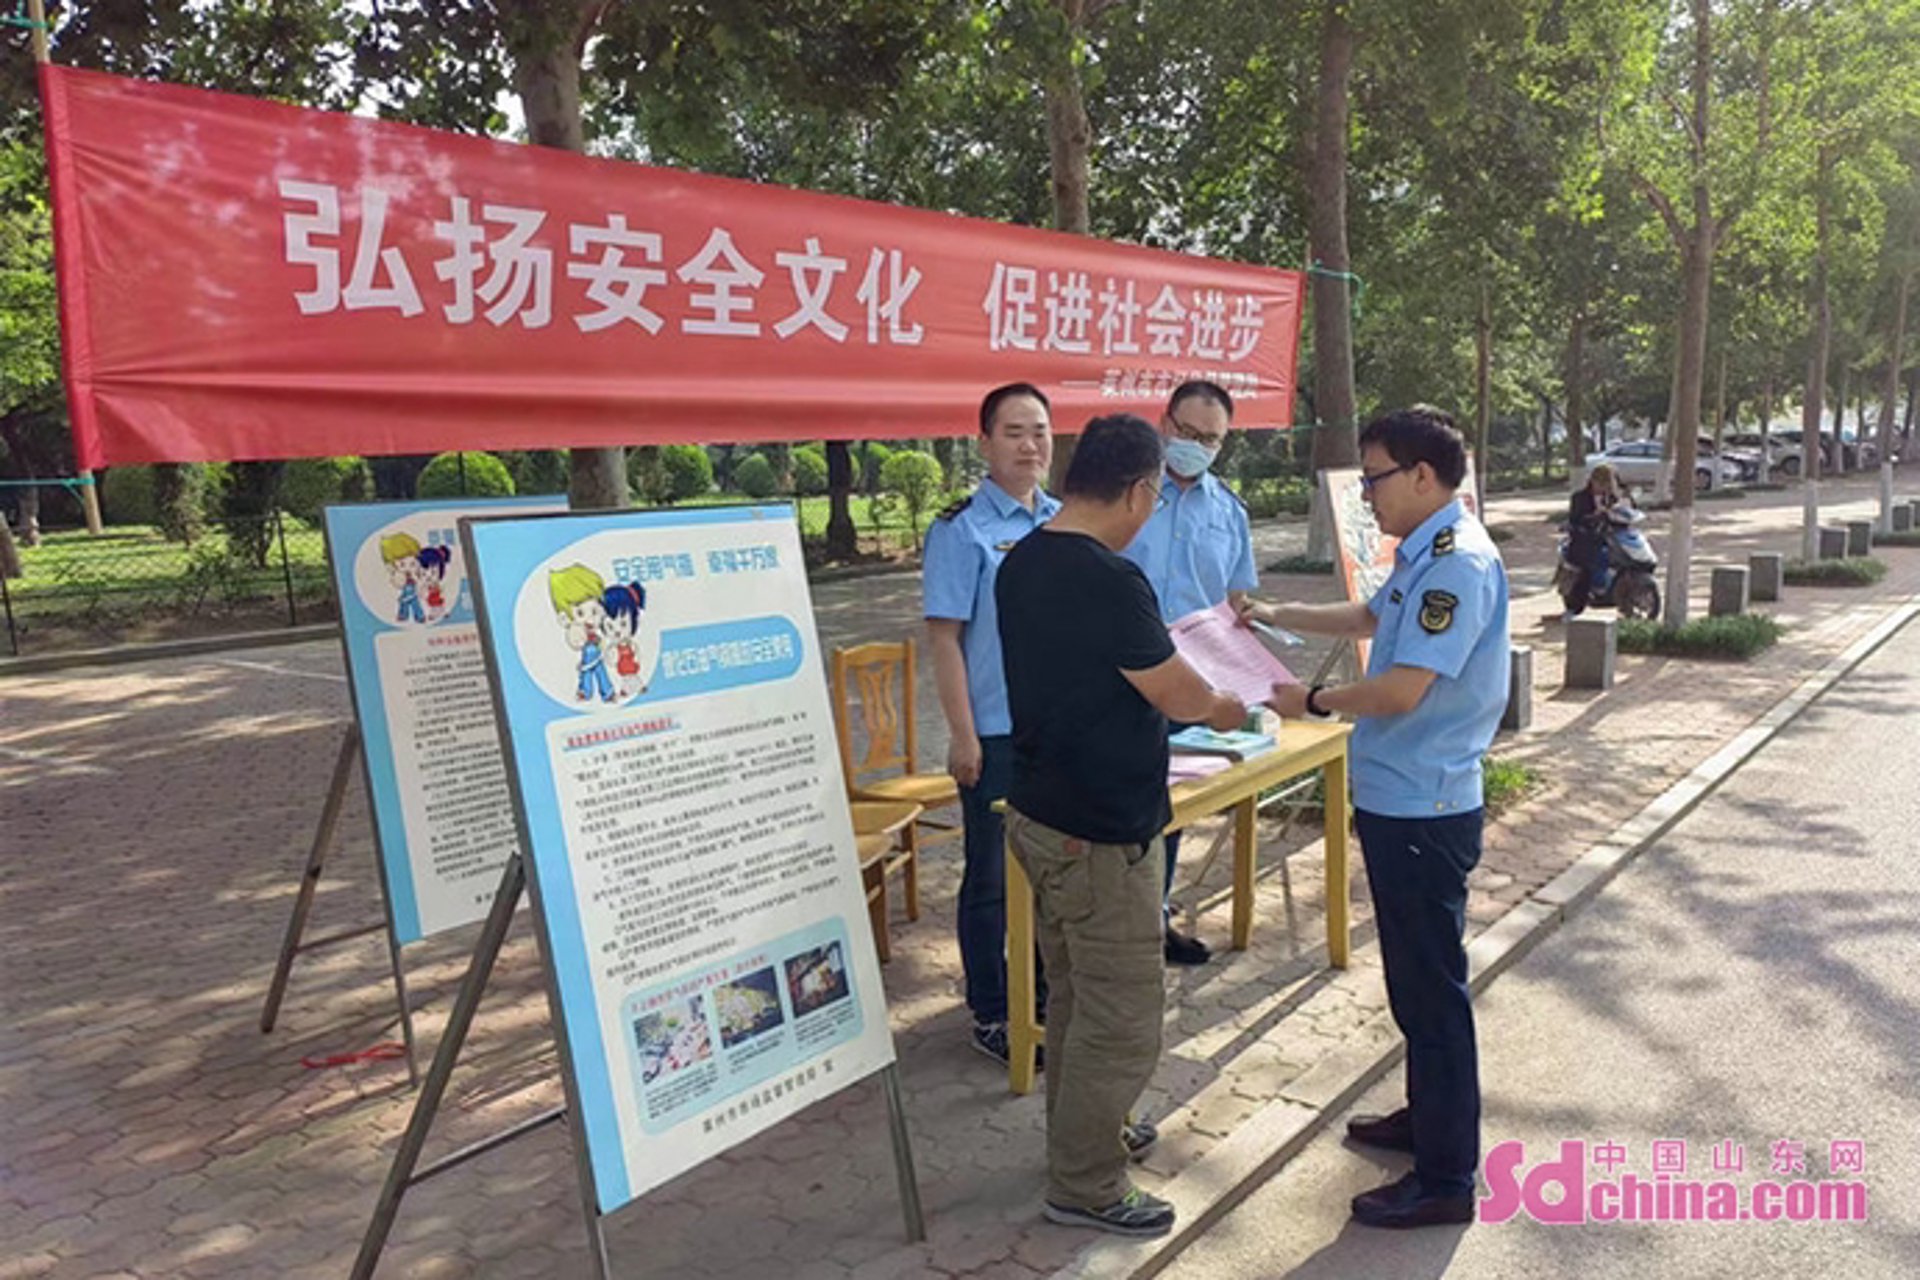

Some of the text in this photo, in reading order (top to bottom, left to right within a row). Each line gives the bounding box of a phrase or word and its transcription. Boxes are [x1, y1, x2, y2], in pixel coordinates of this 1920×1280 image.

[279, 179, 1264, 362] 弘扬安全文化 促进社会进步
